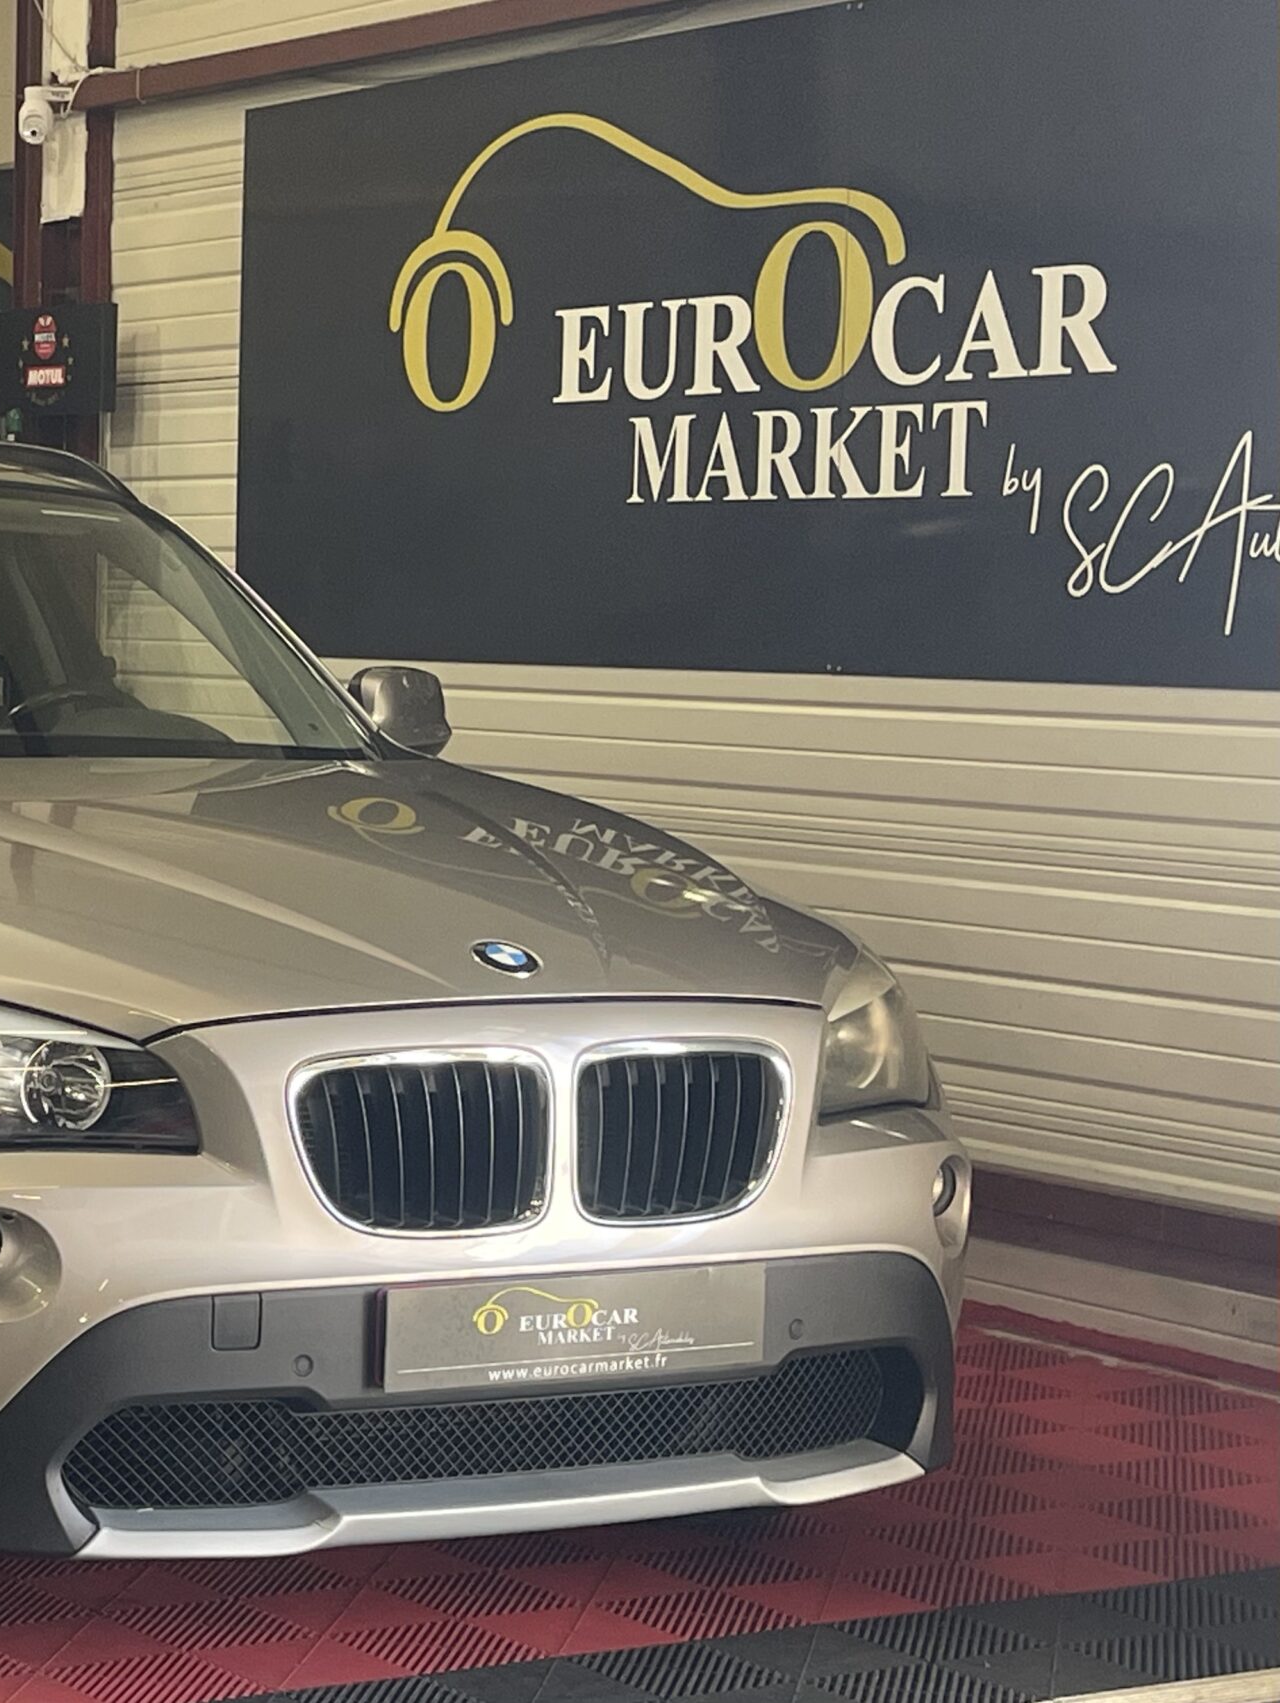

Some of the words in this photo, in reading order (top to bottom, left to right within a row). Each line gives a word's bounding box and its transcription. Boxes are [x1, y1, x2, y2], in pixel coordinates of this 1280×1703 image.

[552, 221, 1118, 405] EUROCAR
[27, 368, 64, 386] MOTUL
[626, 400, 988, 505] MARKET
[1002, 442, 1042, 535] by
[519, 1302, 639, 1332] EUROCAR
[538, 1326, 617, 1346] MARKET
[488, 1352, 668, 1382] www.eurocarmarket.fr
